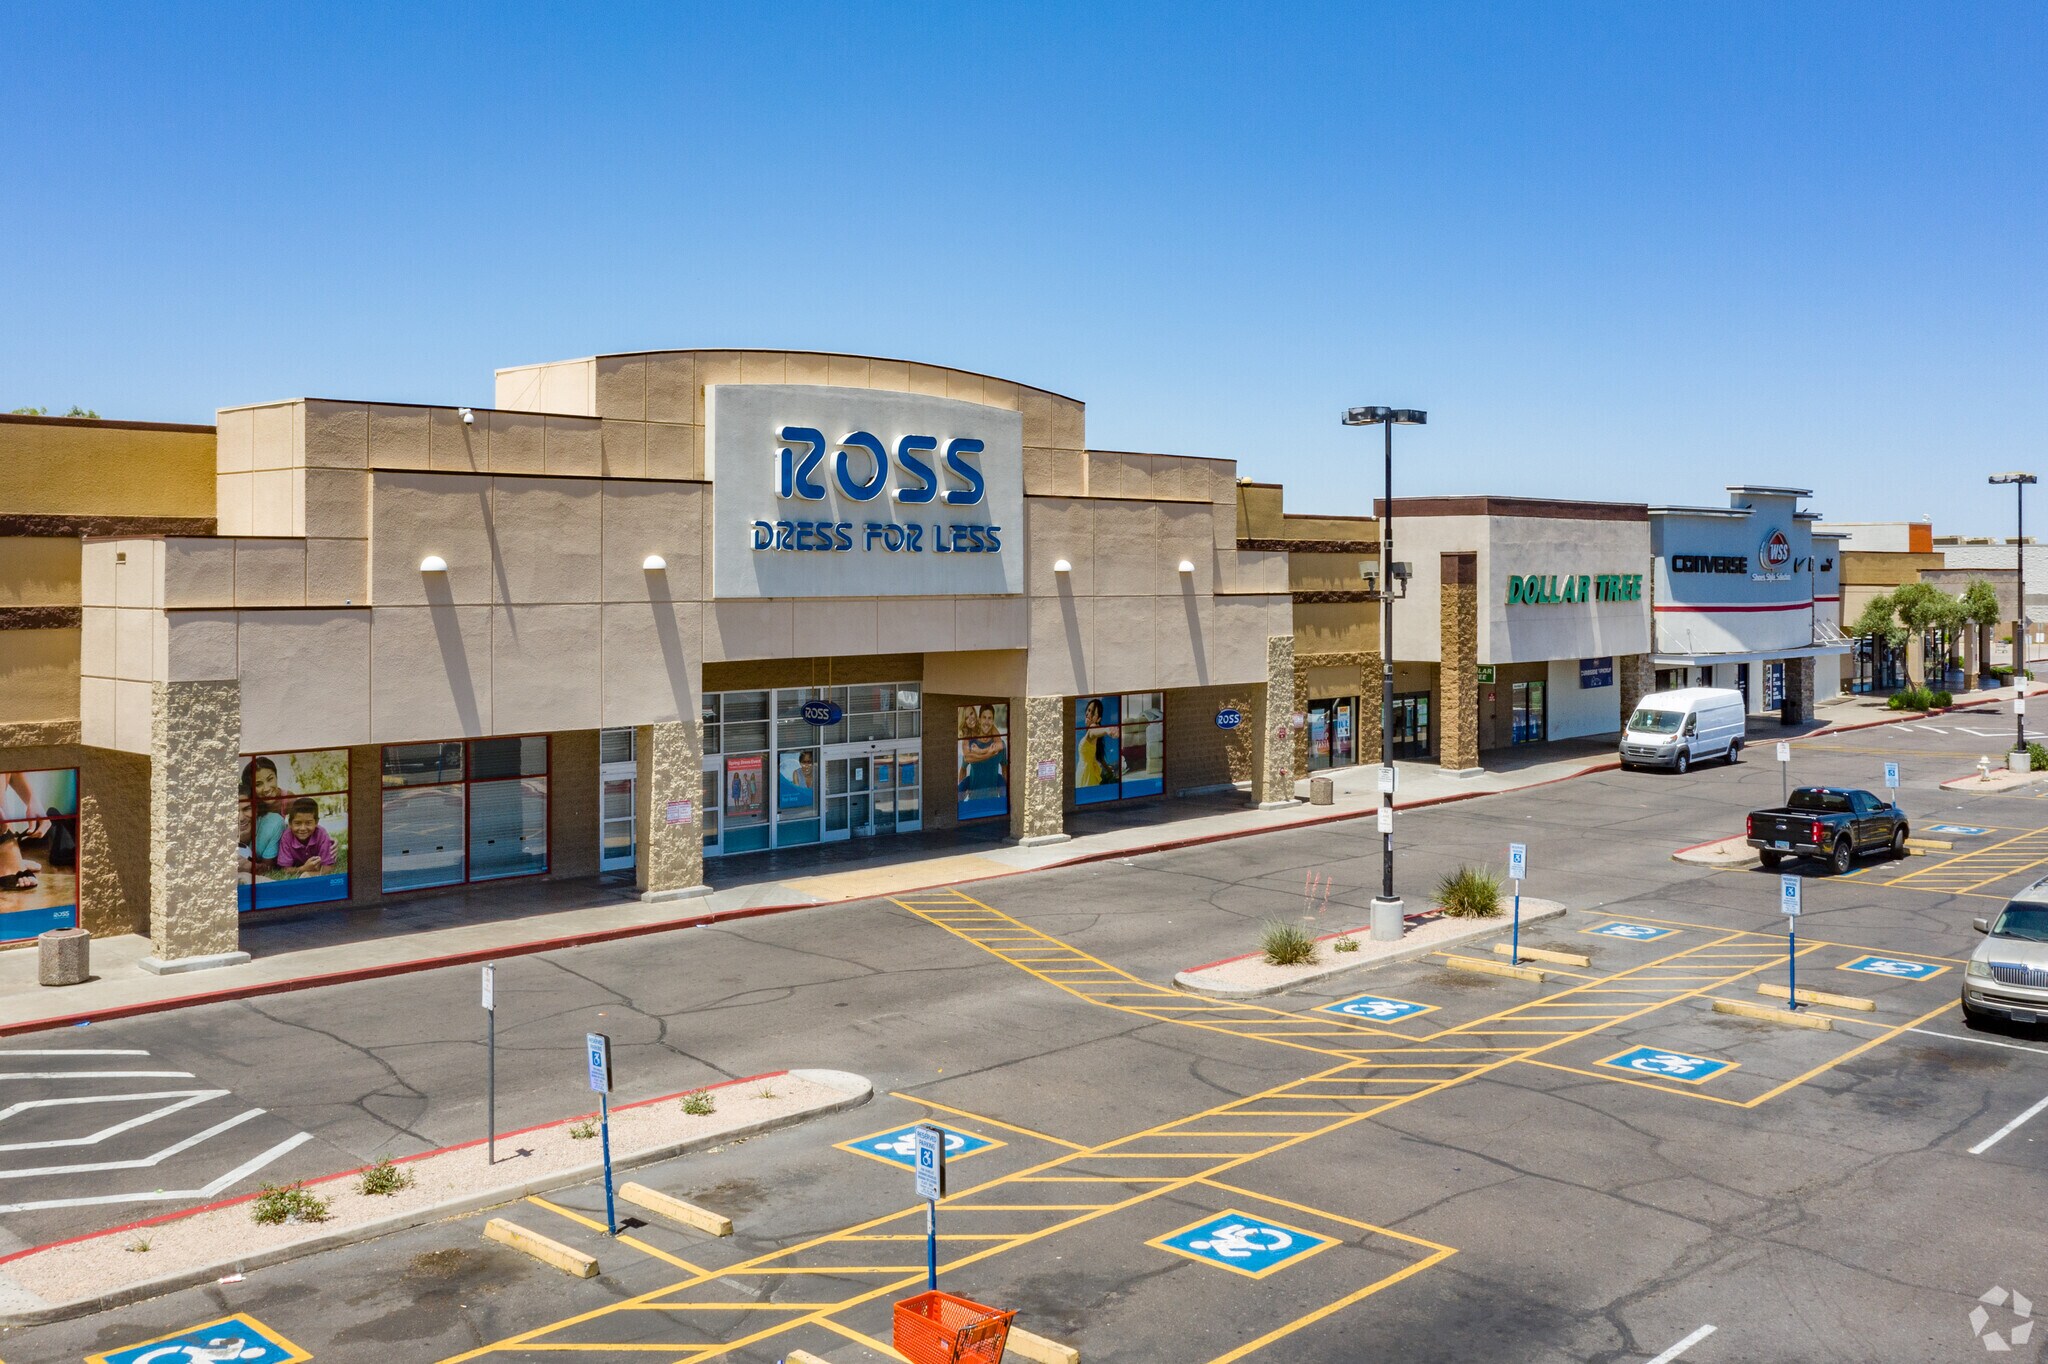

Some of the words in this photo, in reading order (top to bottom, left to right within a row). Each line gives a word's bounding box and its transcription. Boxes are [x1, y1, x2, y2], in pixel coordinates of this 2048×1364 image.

[775, 426, 985, 505] ROSS
[750, 520, 853, 551] DRESS
[863, 523, 924, 552] FOR
[933, 525, 1002, 553] LESS
[1770, 543, 1789, 561] WSS
[1672, 555, 1747, 574] CONVERSE
[1505, 574, 1591, 605] DOLLAR
[1594, 574, 1643, 602] TREE
[805, 707, 830, 720] ROSS
[1218, 714, 1240, 724] ROSS
[916, 1130, 937, 1143] RESERVED
[919, 1140, 936, 1151] PARKING
